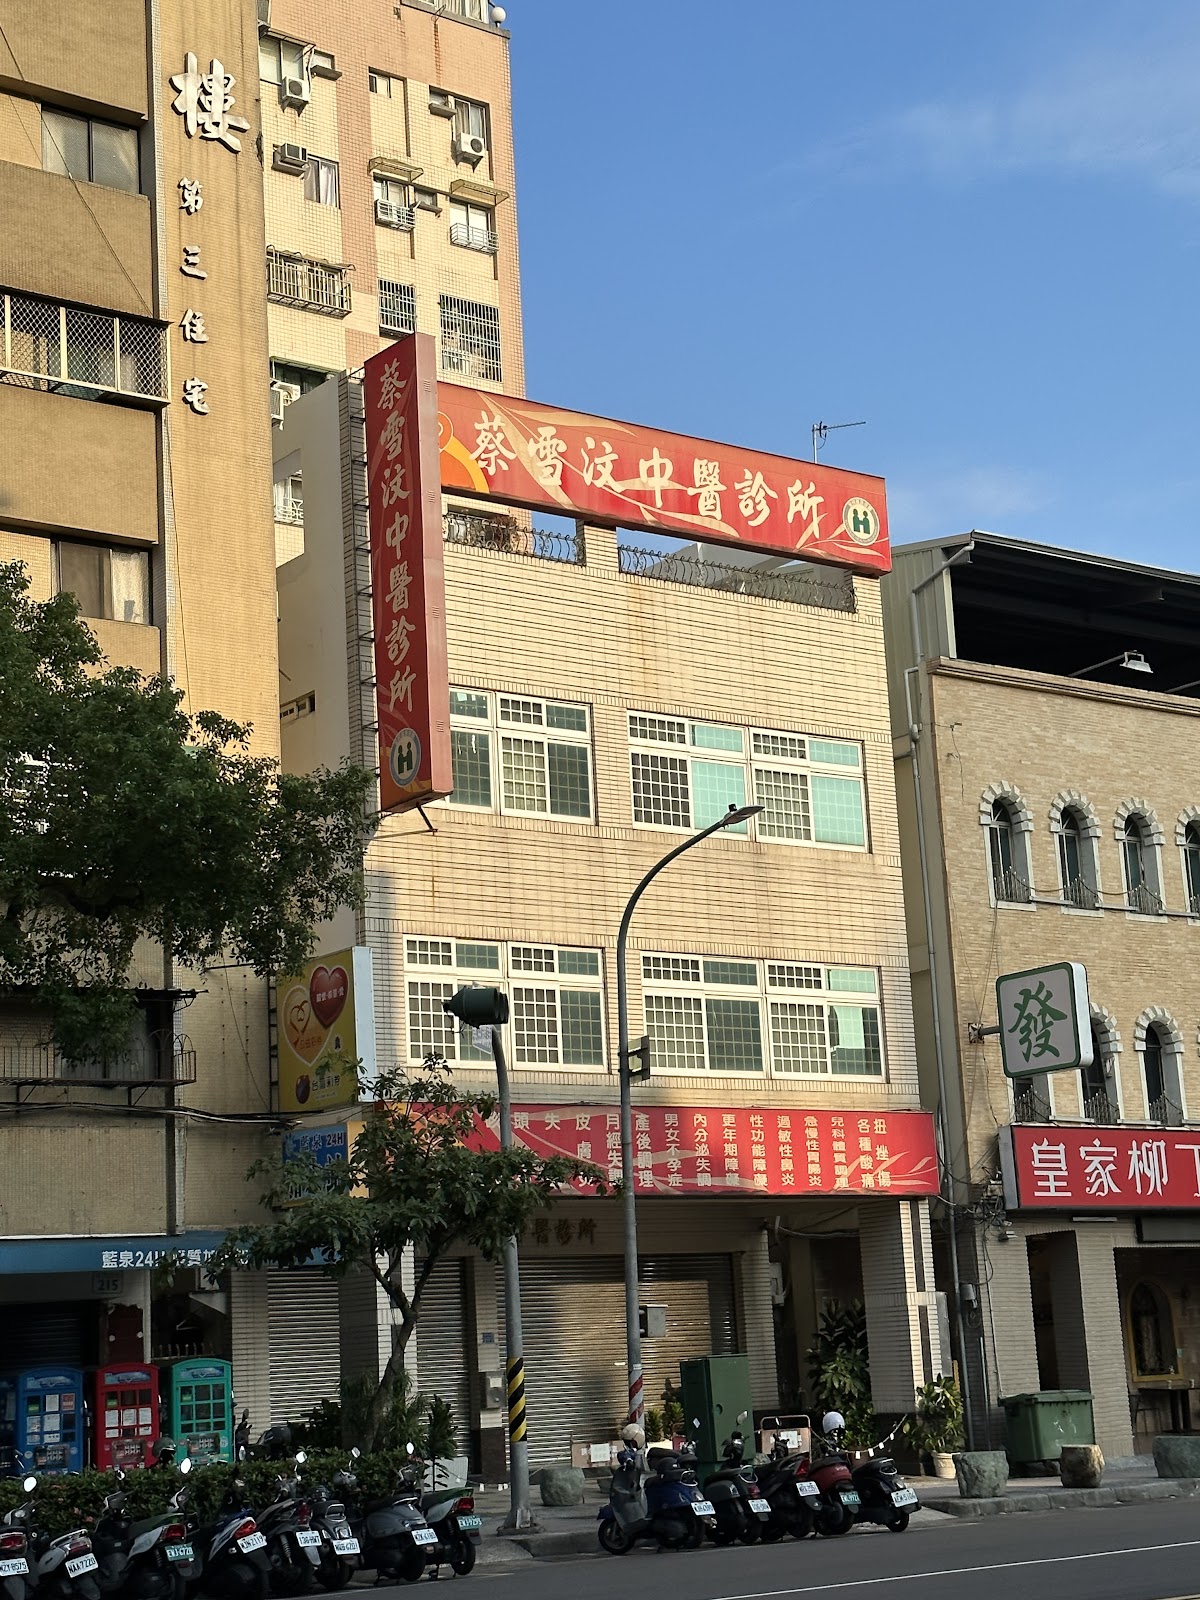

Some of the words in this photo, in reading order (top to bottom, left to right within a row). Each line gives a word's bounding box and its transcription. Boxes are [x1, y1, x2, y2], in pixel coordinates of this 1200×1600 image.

[169, 51, 251, 155] 樓
[177, 176, 211, 415] 第三住宅
[469, 409, 828, 540] 蔡雪汶中醫診所
[377, 357, 417, 714] 蔡雪汶中醫診所
[1008, 980, 1069, 1063] 發
[326, 1131, 345, 1147] 24H
[635, 1113, 654, 1188] 產後調理
[664, 1113, 683, 1188] 男女不孕症
[693, 1113, 712, 1188] 內分泌失調
[721, 1113, 740, 1187] 更年期障礙
[749, 1114, 769, 1188] 性功能障礙
[776, 1115, 796, 1187] 過敏性鼻炎
[803, 1115, 823, 1187] 急慢性胃腸炎
[830, 1116, 849, 1188] 兒科體質調理
[857, 1119, 875, 1189] 各種酸痛
[873, 1118, 892, 1188] 扭挫傷
[519, 1217, 598, 1247] 醫診所
[97, 1278, 119, 1292] 215
